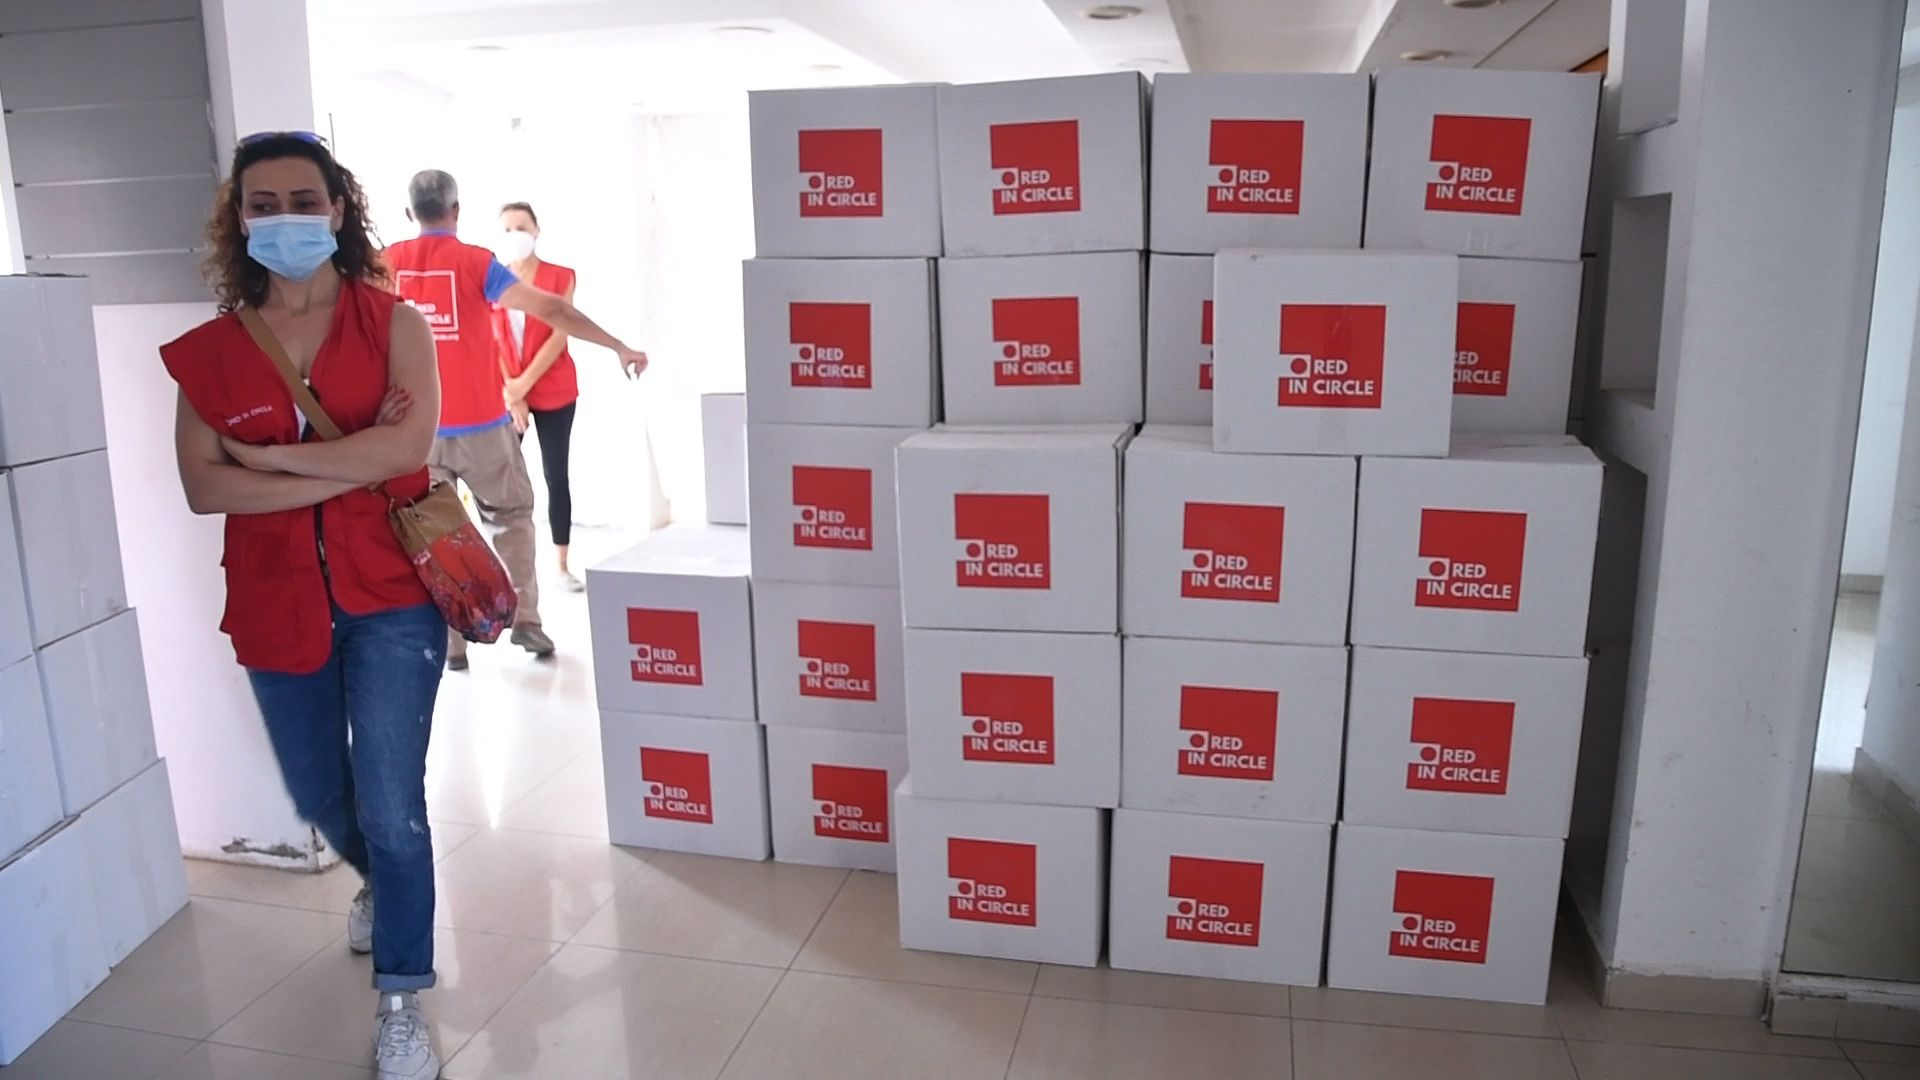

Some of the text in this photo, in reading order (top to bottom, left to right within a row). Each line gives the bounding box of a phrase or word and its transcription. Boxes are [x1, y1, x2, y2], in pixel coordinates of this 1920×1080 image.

[1021, 170, 1050, 184] RED
[1239, 170, 1269, 183] RED
[1460, 167, 1492, 182] RED
[827, 176, 854, 189] RED
[808, 193, 876, 206] IN CIRCLE
[1001, 187, 1073, 203] IN CIRCLE
[1217, 186, 1293, 202] IN CIRCLE
[1436, 184, 1515, 202] IN CIRCLE
[817, 348, 843, 361] RED
[1022, 344, 1050, 357] RED
[799, 363, 864, 378] IN CIRCLE
[1002, 362, 1073, 375] IN CIRCLE
[1314, 360, 1347, 374] RED
[1289, 379, 1373, 395] IN CIRCLE
[819, 510, 845, 523] RED
[801, 524, 865, 540] IN CIRCLE
[987, 544, 1018, 558] RED
[1215, 555, 1248, 570] RED
[966, 563, 1043, 577] IN CIRCLE
[1453, 563, 1486, 578] RED
[1192, 573, 1272, 590] IN CIRCLE
[1427, 581, 1511, 599] IN CIRCLE
[653, 648, 676, 660] RED
[638, 660, 696, 676] IN CIRCLE
[824, 662, 849, 675] RED
[807, 674, 869, 691] IN CIRCLE
[992, 721, 1023, 735] RED
[972, 737, 1047, 753] IN CIRCLE
[1211, 736, 1242, 750] RED
[1188, 751, 1266, 769] IN CIRCLE
[1443, 749, 1475, 763] RED
[1418, 766, 1500, 783] IN CIRCLE
[665, 787, 688, 799] RED
[651, 800, 706, 815] IN CIRCLE
[838, 805, 863, 817] RED
[821, 816, 882, 833] IN CIRCLE
[977, 884, 1006, 898] RED
[957, 896, 1029, 916] IN CIRCLE
[1199, 904, 1229, 917] RED
[1176, 916, 1252, 936] IN CIRCLE
[1424, 919, 1456, 933] RED
[1400, 933, 1479, 952] IN CIRCLE
